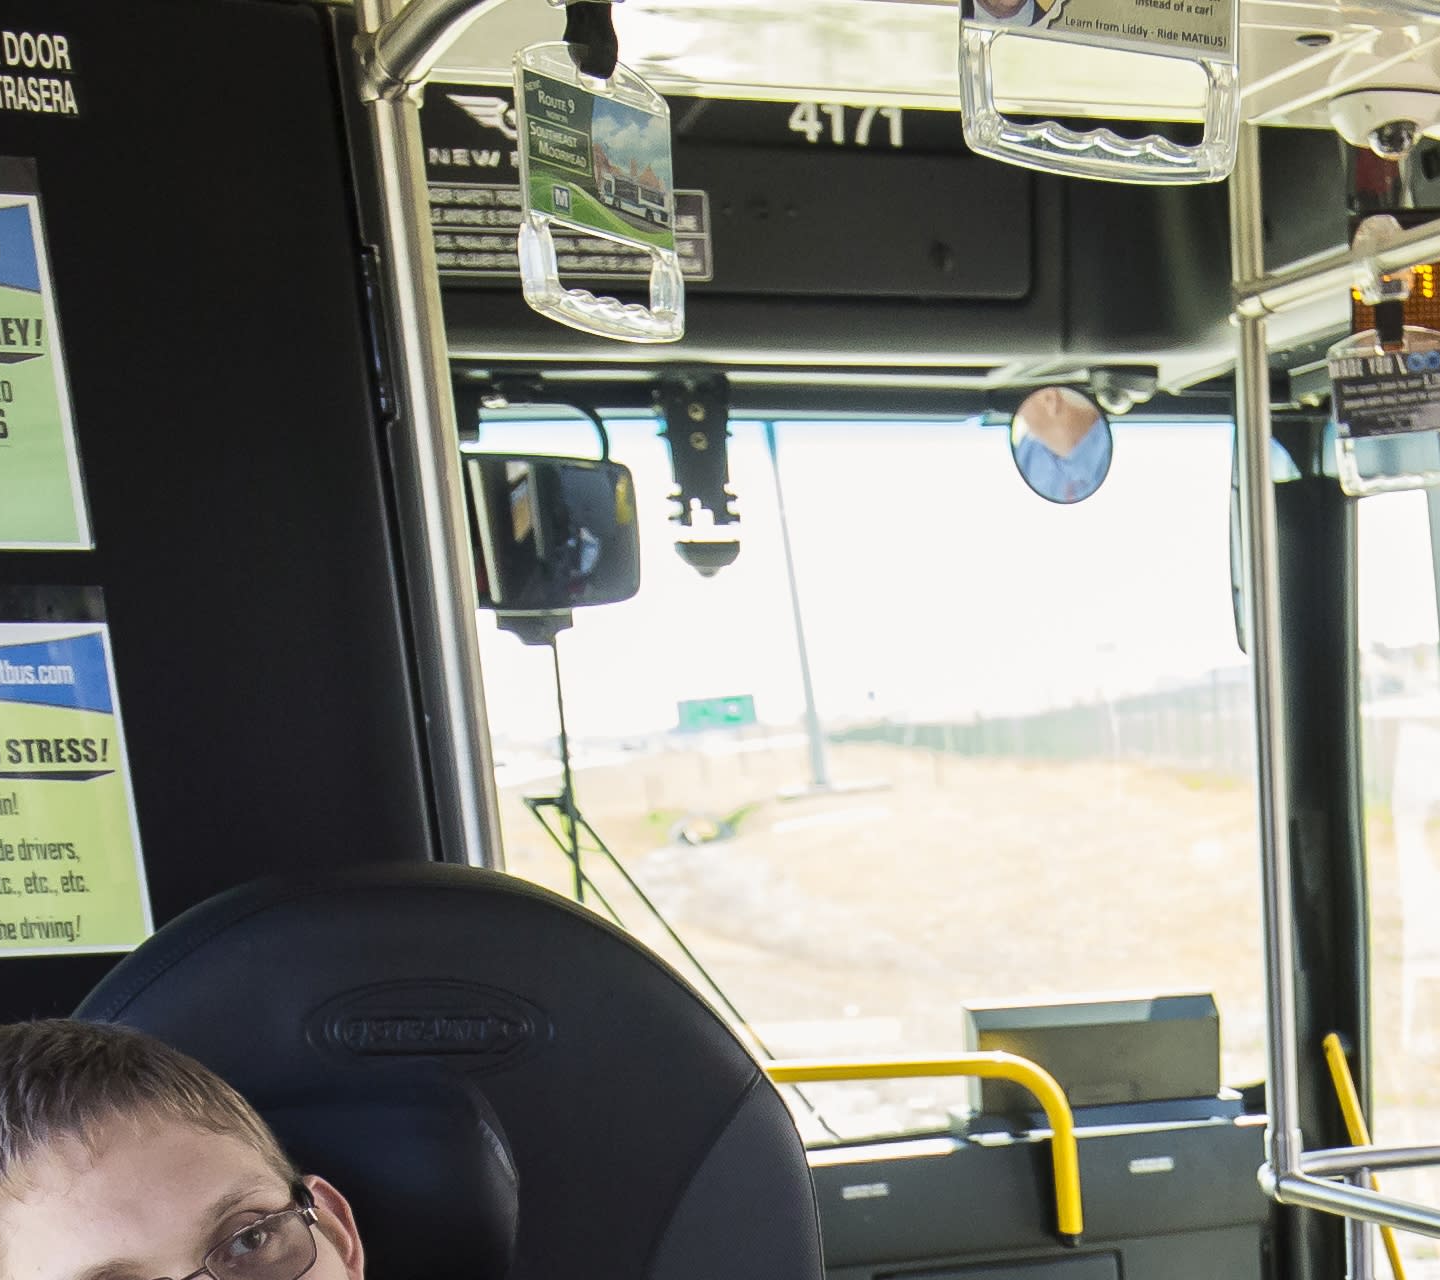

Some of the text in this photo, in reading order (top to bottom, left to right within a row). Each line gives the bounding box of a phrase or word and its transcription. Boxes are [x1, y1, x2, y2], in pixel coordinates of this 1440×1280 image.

[1174, 2, 1184, 12] of
[1065, 15, 1092, 28] Learn
[1095, 19, 1119, 32] from
[1122, 23, 1148, 38] Liddy
[1157, 28, 1179, 41] Ride
[2, 31, 72, 70] DOOR
[788, 101, 903, 147] 4171
[429, 148, 502, 168] NEW
[6, 738, 108, 763] STRESS!
[17, 838, 81, 862] drivers,
[61, 870, 91, 893] etc.
[20, 914, 81, 942] driving!
